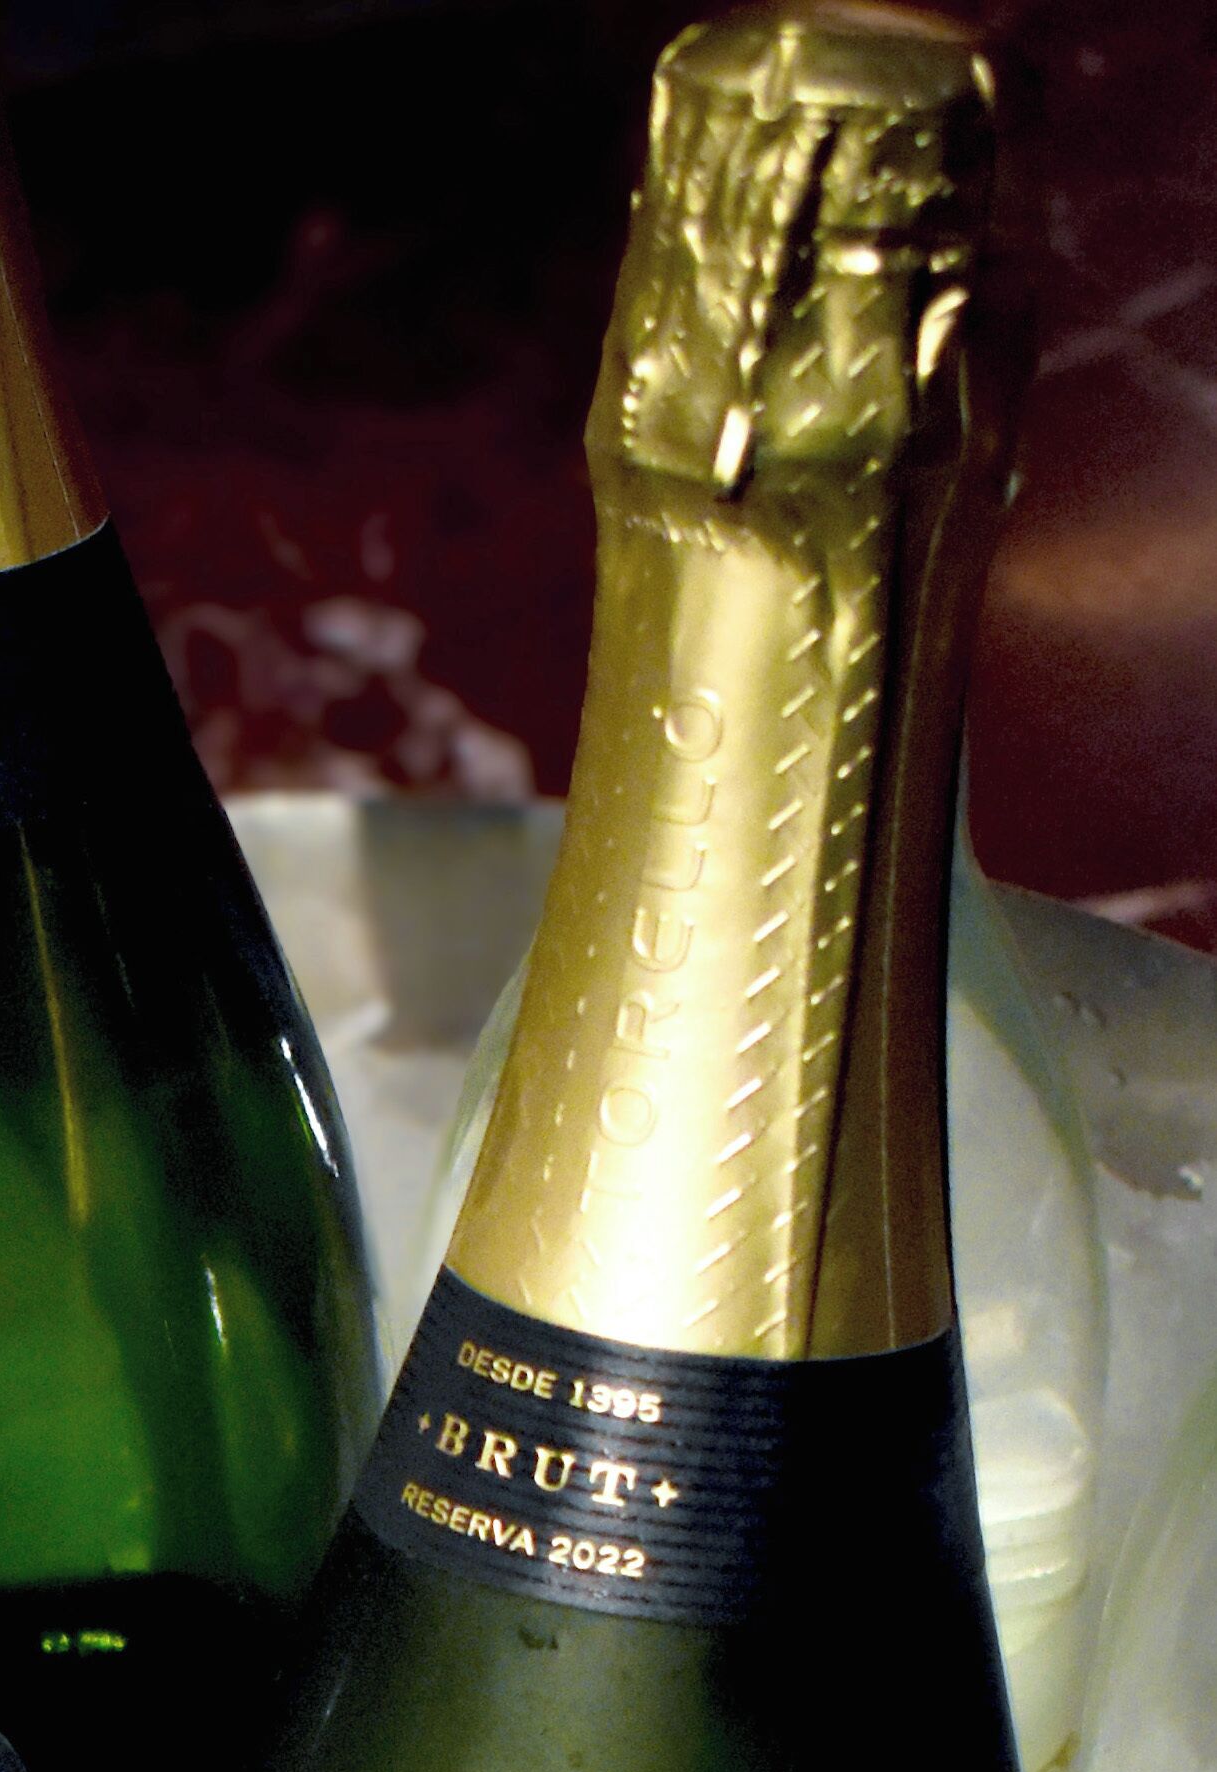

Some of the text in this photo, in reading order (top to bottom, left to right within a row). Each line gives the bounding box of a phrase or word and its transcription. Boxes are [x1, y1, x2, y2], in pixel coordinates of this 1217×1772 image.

[457, 1340, 662, 1425] DESDE 1395
[436, 1410, 637, 1508] BRUT
[400, 1480, 647, 1580] RESERVA 2022
